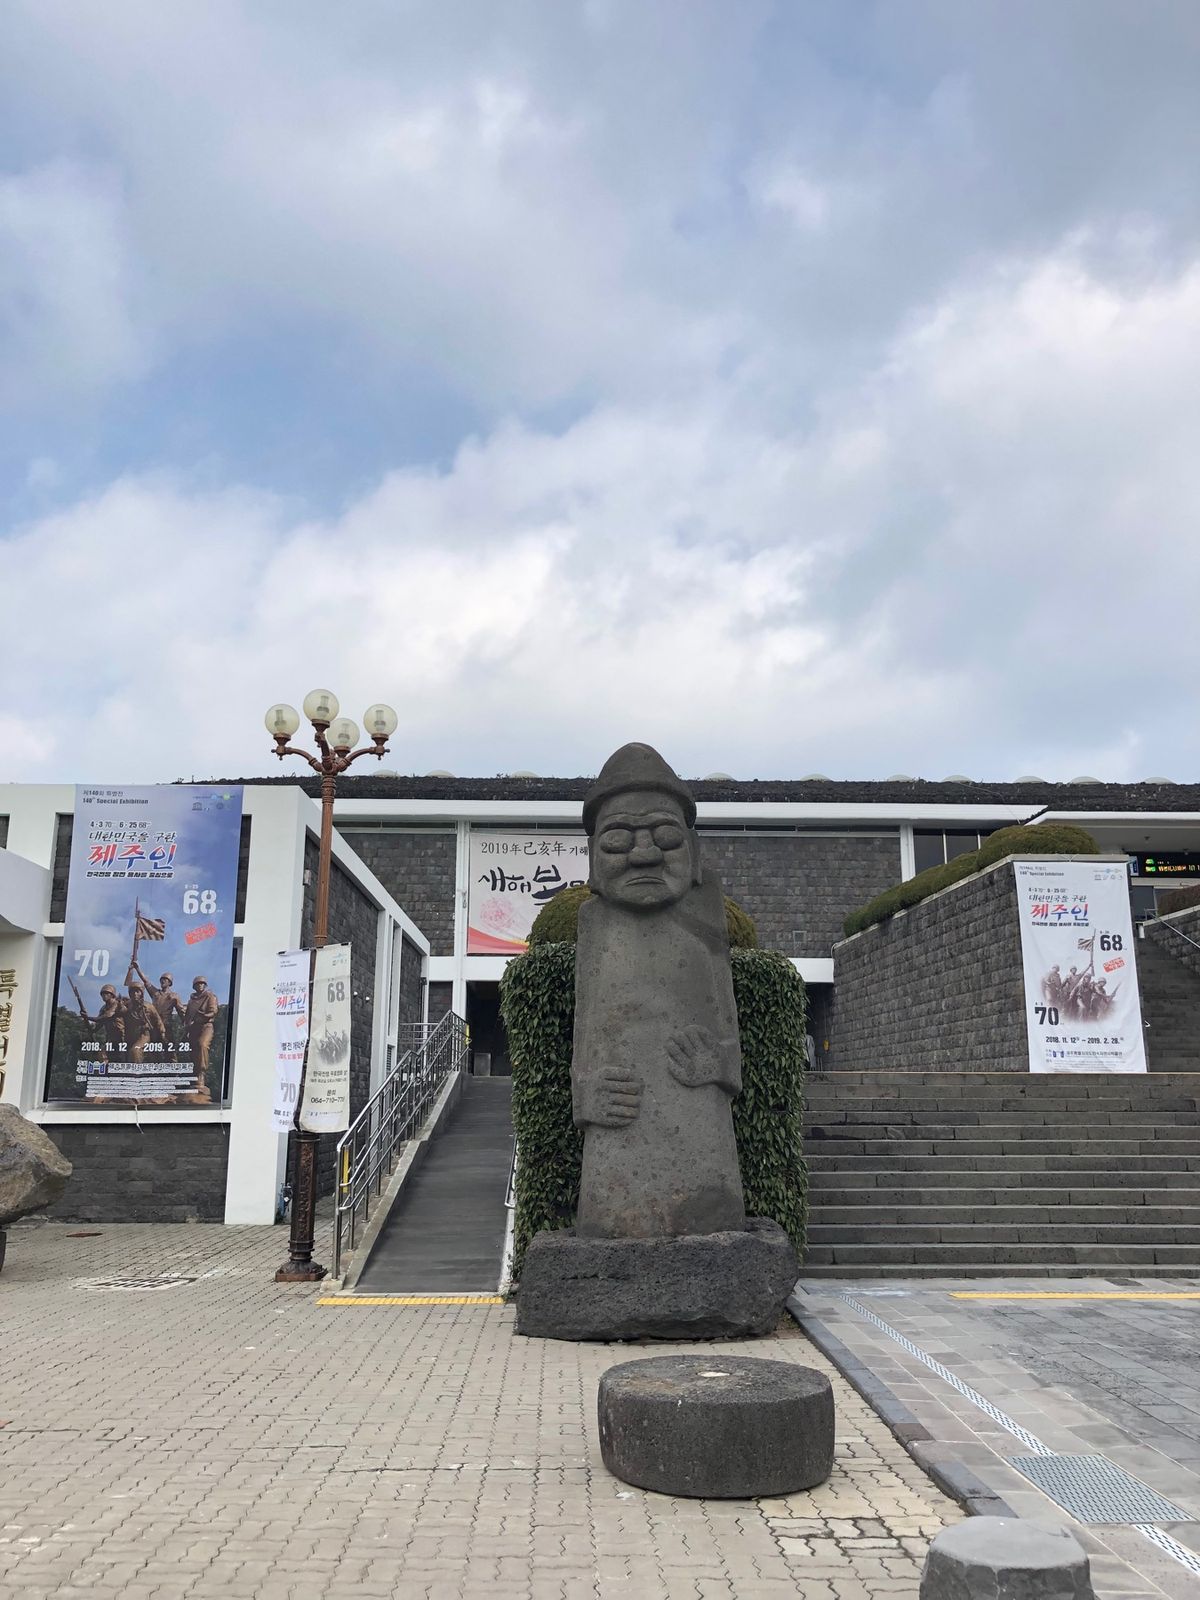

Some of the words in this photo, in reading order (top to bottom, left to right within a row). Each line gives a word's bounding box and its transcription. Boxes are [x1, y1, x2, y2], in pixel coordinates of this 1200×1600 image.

[89, 831, 149, 843] 대한민국을
[154, 832, 176, 843] 구한
[88, 844, 176, 870] 제주인
[478, 866, 531, 893] 새해
[182, 890, 217, 914] 68
[1030, 904, 1089, 921] 제주인
[1100, 934, 1123, 951] 68
[74, 949, 110, 977] 70
[276, 993, 307, 1010] 제주인
[328, 981, 345, 1003] 68
[1034, 1007, 1059, 1026] 70
[81, 1042, 101, 1051] 2018.
[105, 1042, 114, 1051] 11.
[119, 1042, 127, 1051] 12
[144, 1043, 164, 1052] 2019.
[168, 1043, 175, 1052] 2.
[178, 1042, 192, 1052] 28.
[280, 1082, 296, 1102] 70
